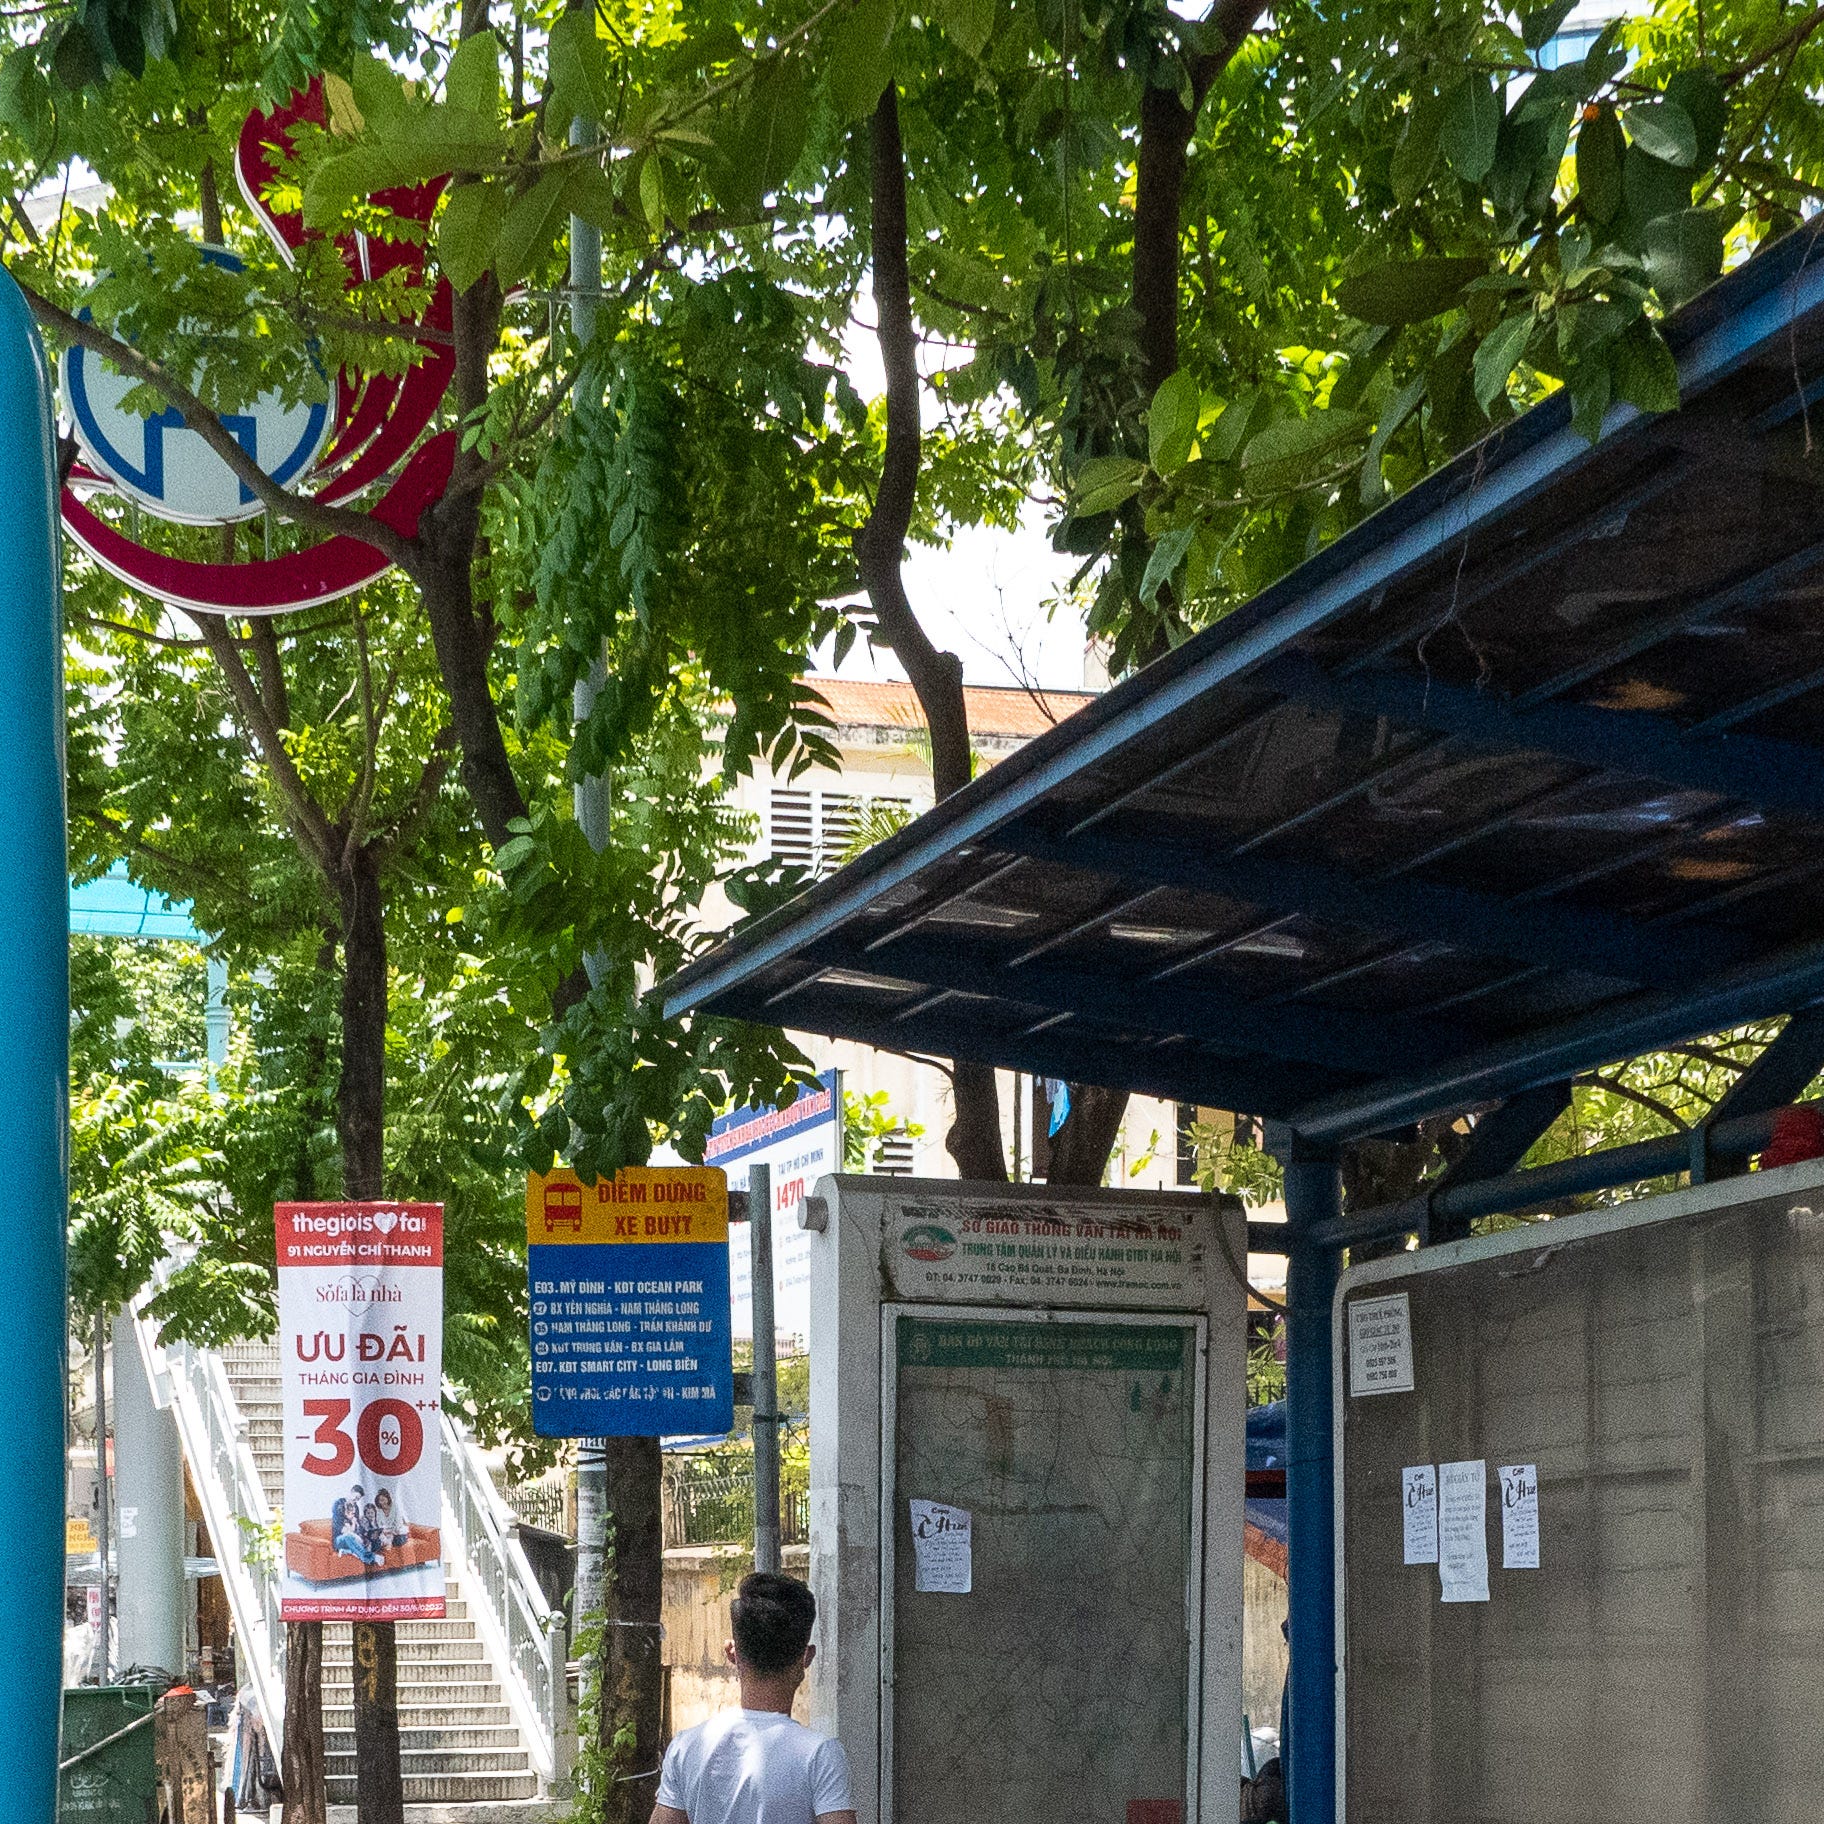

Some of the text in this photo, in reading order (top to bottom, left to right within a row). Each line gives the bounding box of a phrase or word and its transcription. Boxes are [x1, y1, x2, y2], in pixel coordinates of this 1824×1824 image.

[776, 1176, 804, 1211] 1470
[615, 1211, 692, 1236] XE BUÝT
[985, 1218, 1019, 1235] GIAO
[287, 1240, 432, 1257] 91 NGUYỄN CHÍ THANH
[962, 1243, 992, 1256] TRUNG
[998, 1263, 1016, 1273] Cao
[1057, 1265, 1069, 1274] Ba
[351, 1284, 366, 1302] là
[371, 1284, 402, 1302] nhà
[579, 1279, 605, 1294] ĐÌNH
[638, 1281, 673, 1294] OCEAN
[676, 1281, 703, 1294] PARK
[621, 1303, 641, 1314] NAM
[676, 1302, 700, 1314] LONG
[607, 1321, 630, 1333] LONG
[296, 1325, 426, 1363] ƯU ĐÃI
[572, 1341, 602, 1353] TRUNG
[631, 1342, 644, 1353] BX
[646, 1341, 662, 1353] GIA
[580, 1360, 614, 1373] SMART
[616, 1359, 638, 1372] CITY
[646, 1359, 672, 1372] LONG
[675, 1356, 698, 1371] BIÊN
[298, 1370, 425, 1385] THÁNG GIA ĐÌNH
